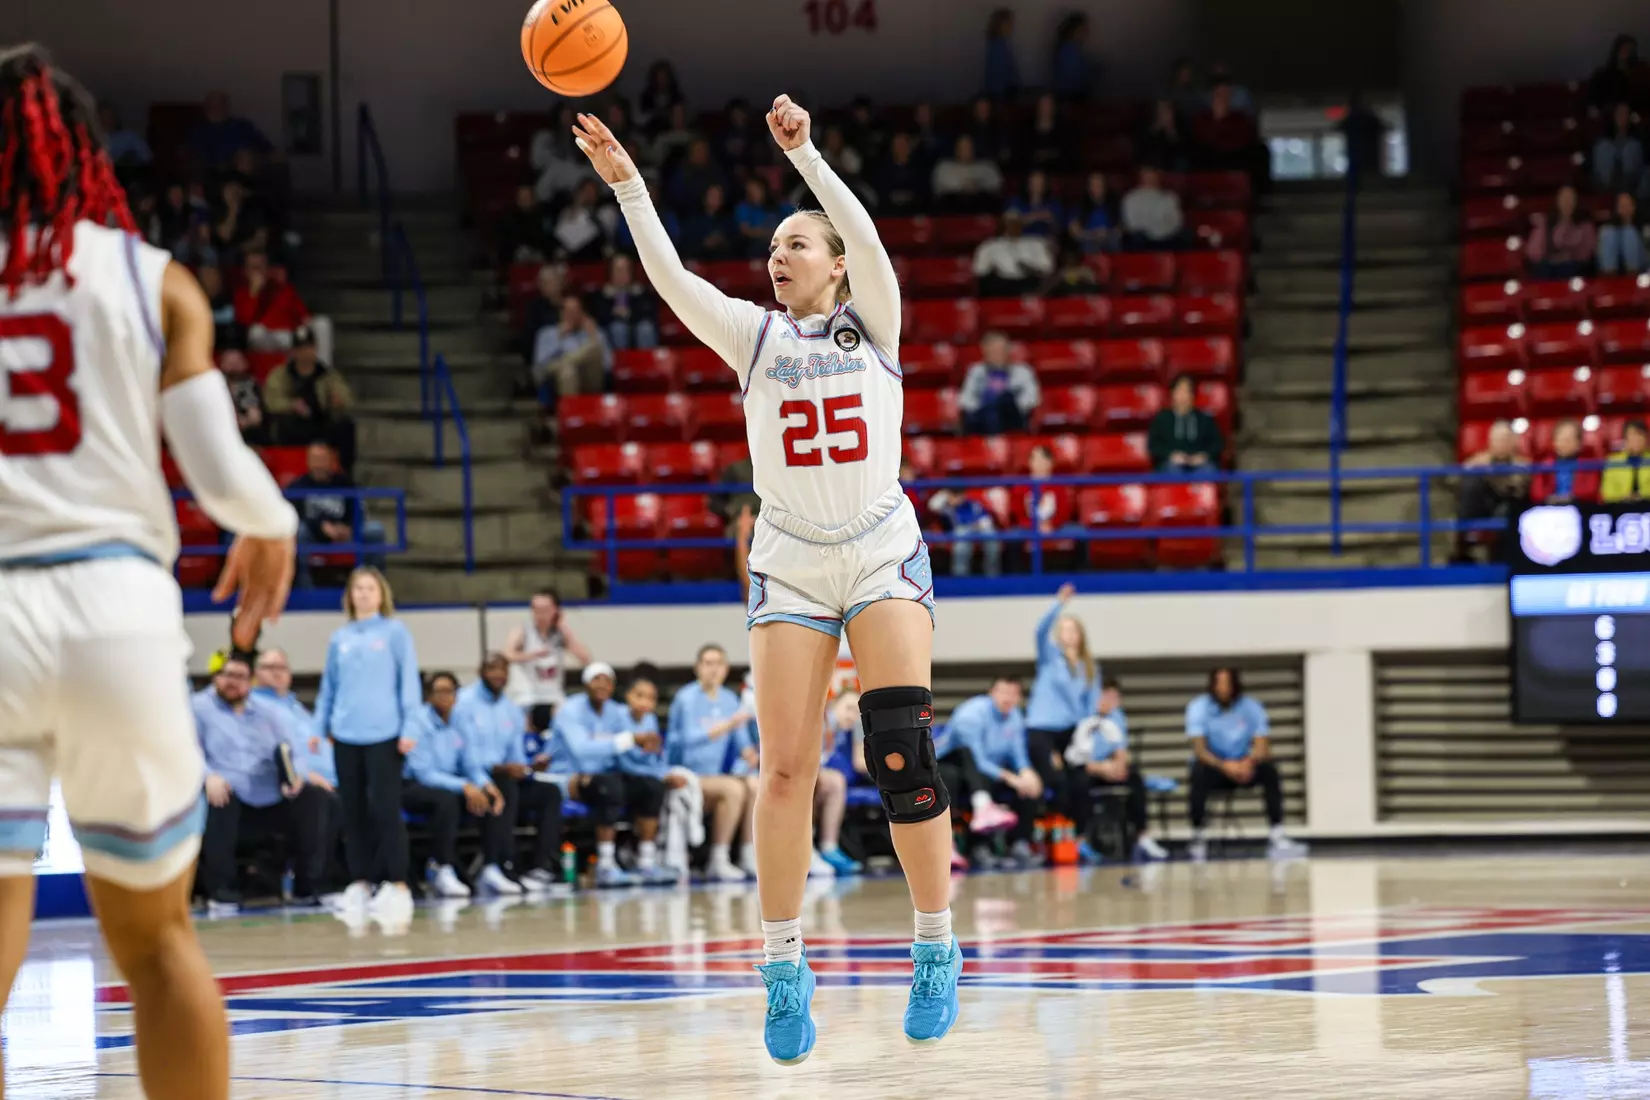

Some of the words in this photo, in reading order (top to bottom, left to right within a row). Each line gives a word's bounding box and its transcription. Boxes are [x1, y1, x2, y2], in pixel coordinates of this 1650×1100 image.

[803, 0, 879, 36] 104
[765, 355, 806, 389] Lady
[779, 393, 868, 467] 25
